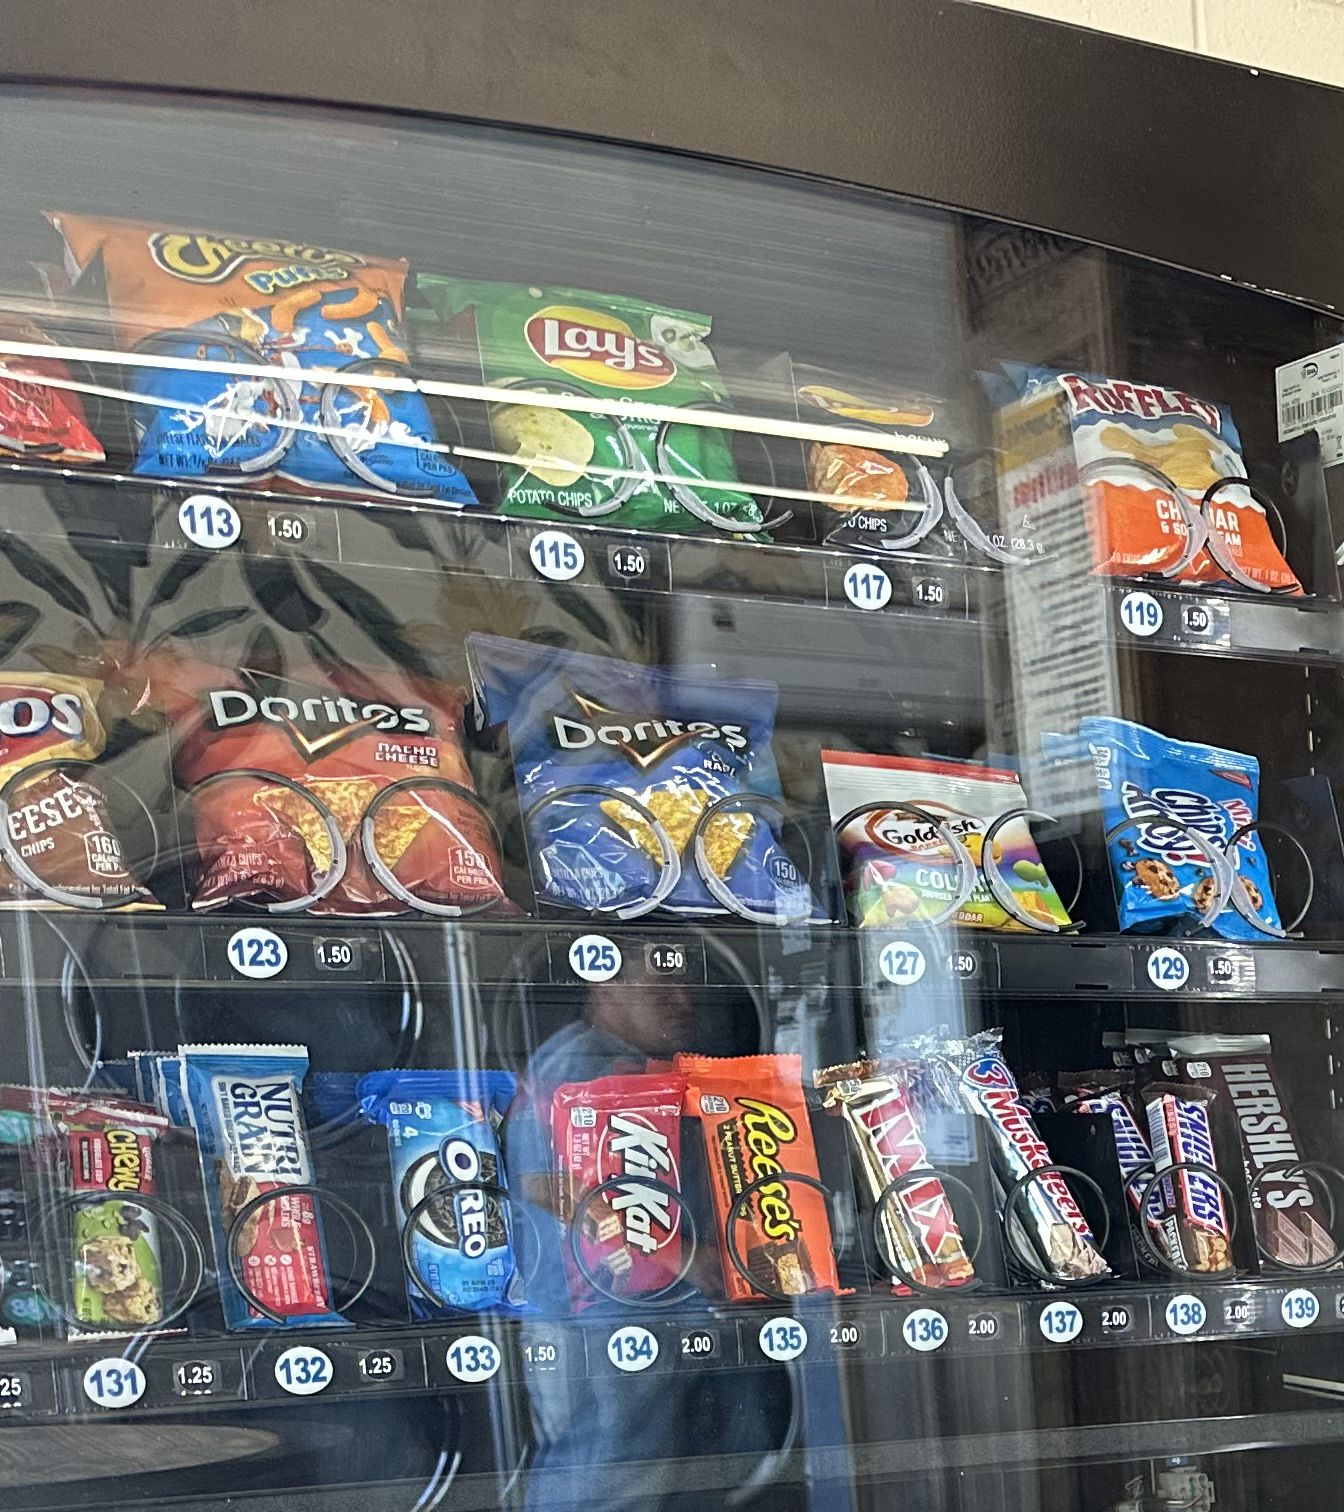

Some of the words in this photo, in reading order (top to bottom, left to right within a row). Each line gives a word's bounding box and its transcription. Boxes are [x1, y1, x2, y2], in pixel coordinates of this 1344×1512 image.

[543, 318, 663, 371] Lay's
[1060, 374, 1221, 433] RUFFLES
[557, 491, 593, 507] CHIPS
[183, 504, 235, 533] 113
[267, 517, 302, 539] 1.50
[858, 515, 888, 532] CHIPS
[534, 539, 578, 570] 115
[614, 552, 645, 573] 1.50
[848, 572, 886, 600] 117
[916, 585, 943, 602] 1.50
[1124, 598, 1159, 626] 119
[1182, 611, 1207, 628] 1.50
[209, 689, 430, 733] Doritos
[554, 716, 747, 749] Doritos
[375, 752, 439, 768] CHEESE
[378, 742, 437, 756] NACHO
[8, 786, 83, 841] EESE
[20, 837, 55, 857] CHIPS
[231, 938, 282, 968] 123
[317, 946, 351, 963] 1.50
[573, 944, 616, 974] 125
[653, 951, 683, 967] 1.50
[883, 951, 919, 976] 127
[946, 956, 973, 971] 1.50
[1151, 956, 1185, 980] 129
[1208, 959, 1231, 974] 1.50
[229, 1082, 266, 1175] GRAIN
[255, 1081, 302, 1177] NUTRI
[736, 1097, 798, 1242] Reese's
[439, 1133, 488, 1259] OREO
[611, 1181, 671, 1254] Kat
[1044, 1310, 1078, 1333] 137
[1102, 1309, 1127, 1326] 2.00
[1169, 1303, 1201, 1325] 138
[1225, 1304, 1249, 1319] 2.00
[1285, 1297, 1316, 1319] 139
[763, 1324, 801, 1352] 135
[830, 1328, 858, 1344] 2.00
[906, 1317, 945, 1342] 136
[969, 1318, 995, 1335] 2.00
[450, 1345, 496, 1372] 133
[525, 1345, 556, 1363] 1.50
[611, 1336, 654, 1362] 134
[682, 1336, 711, 1353] 2.00
[89, 1369, 139, 1398] 131
[177, 1366, 213, 1385] 1.25
[279, 1359, 328, 1386] 132
[359, 1356, 392, 1375] 1.25
